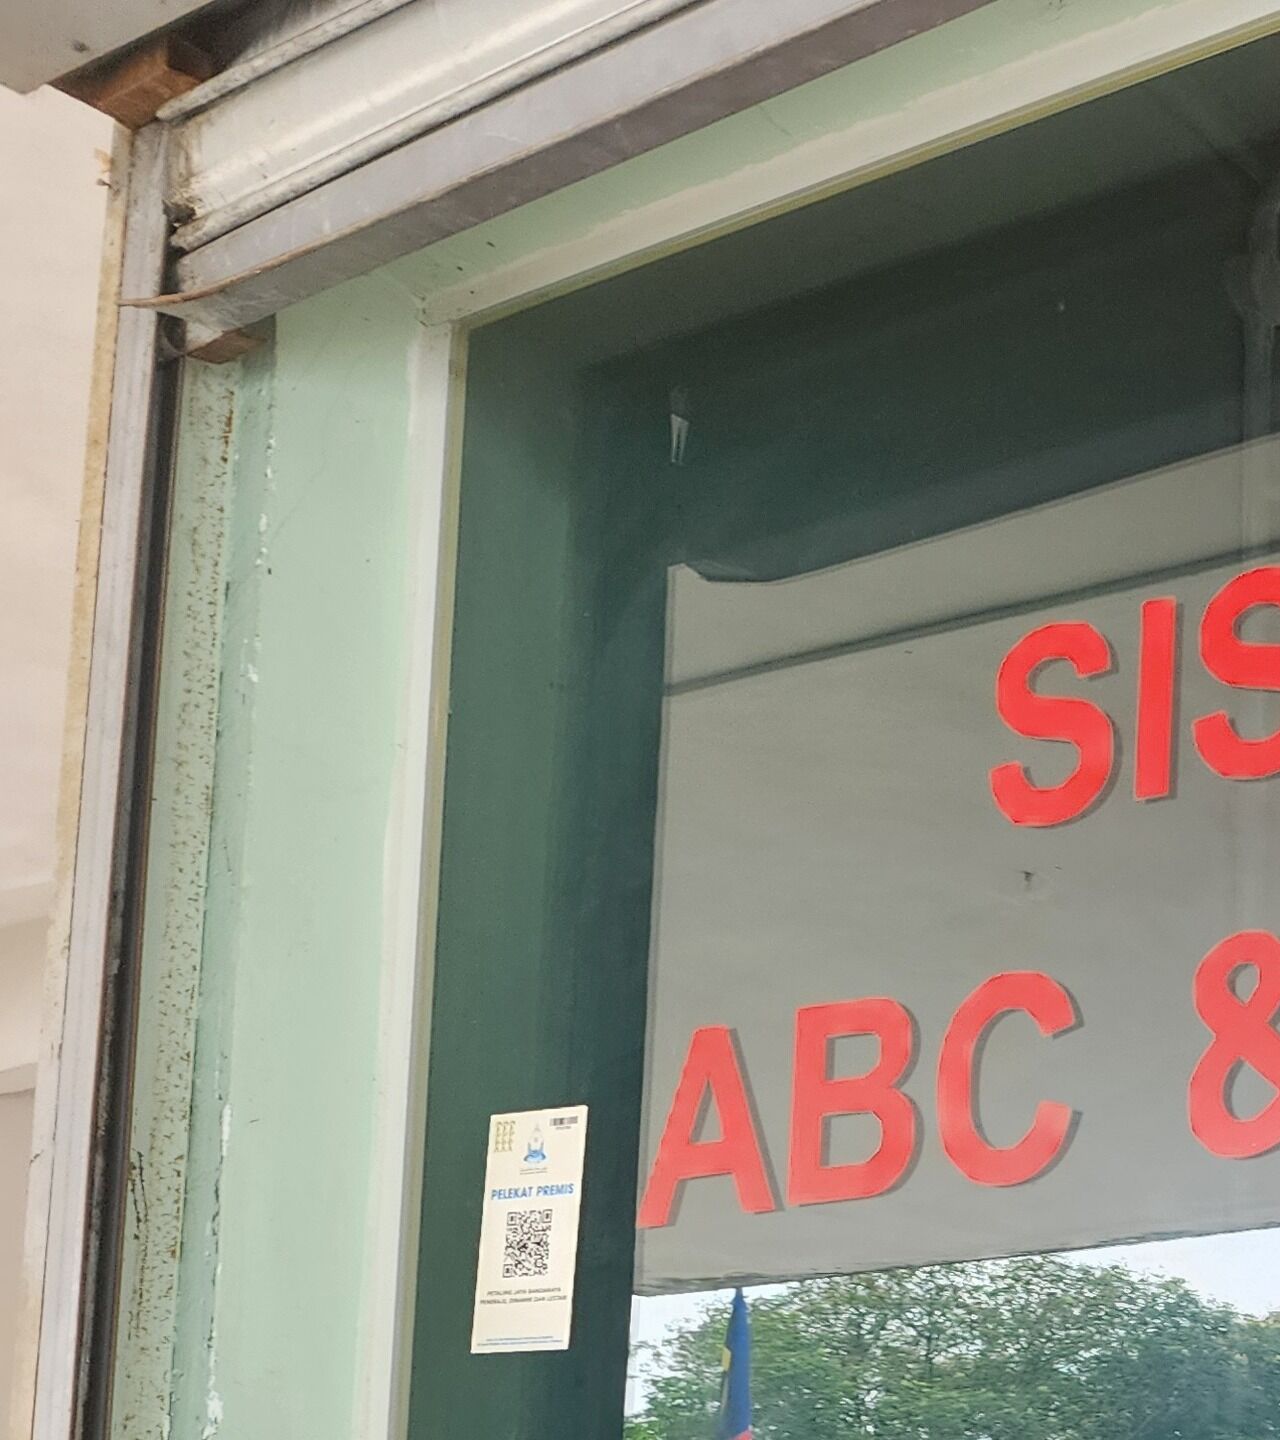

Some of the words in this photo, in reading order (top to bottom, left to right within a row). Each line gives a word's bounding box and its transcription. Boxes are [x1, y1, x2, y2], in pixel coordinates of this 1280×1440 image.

[638, 971, 1078, 1230] ABC
[490, 1186, 533, 1200] PELEKAT
[536, 1183, 575, 1197] PREMIS
